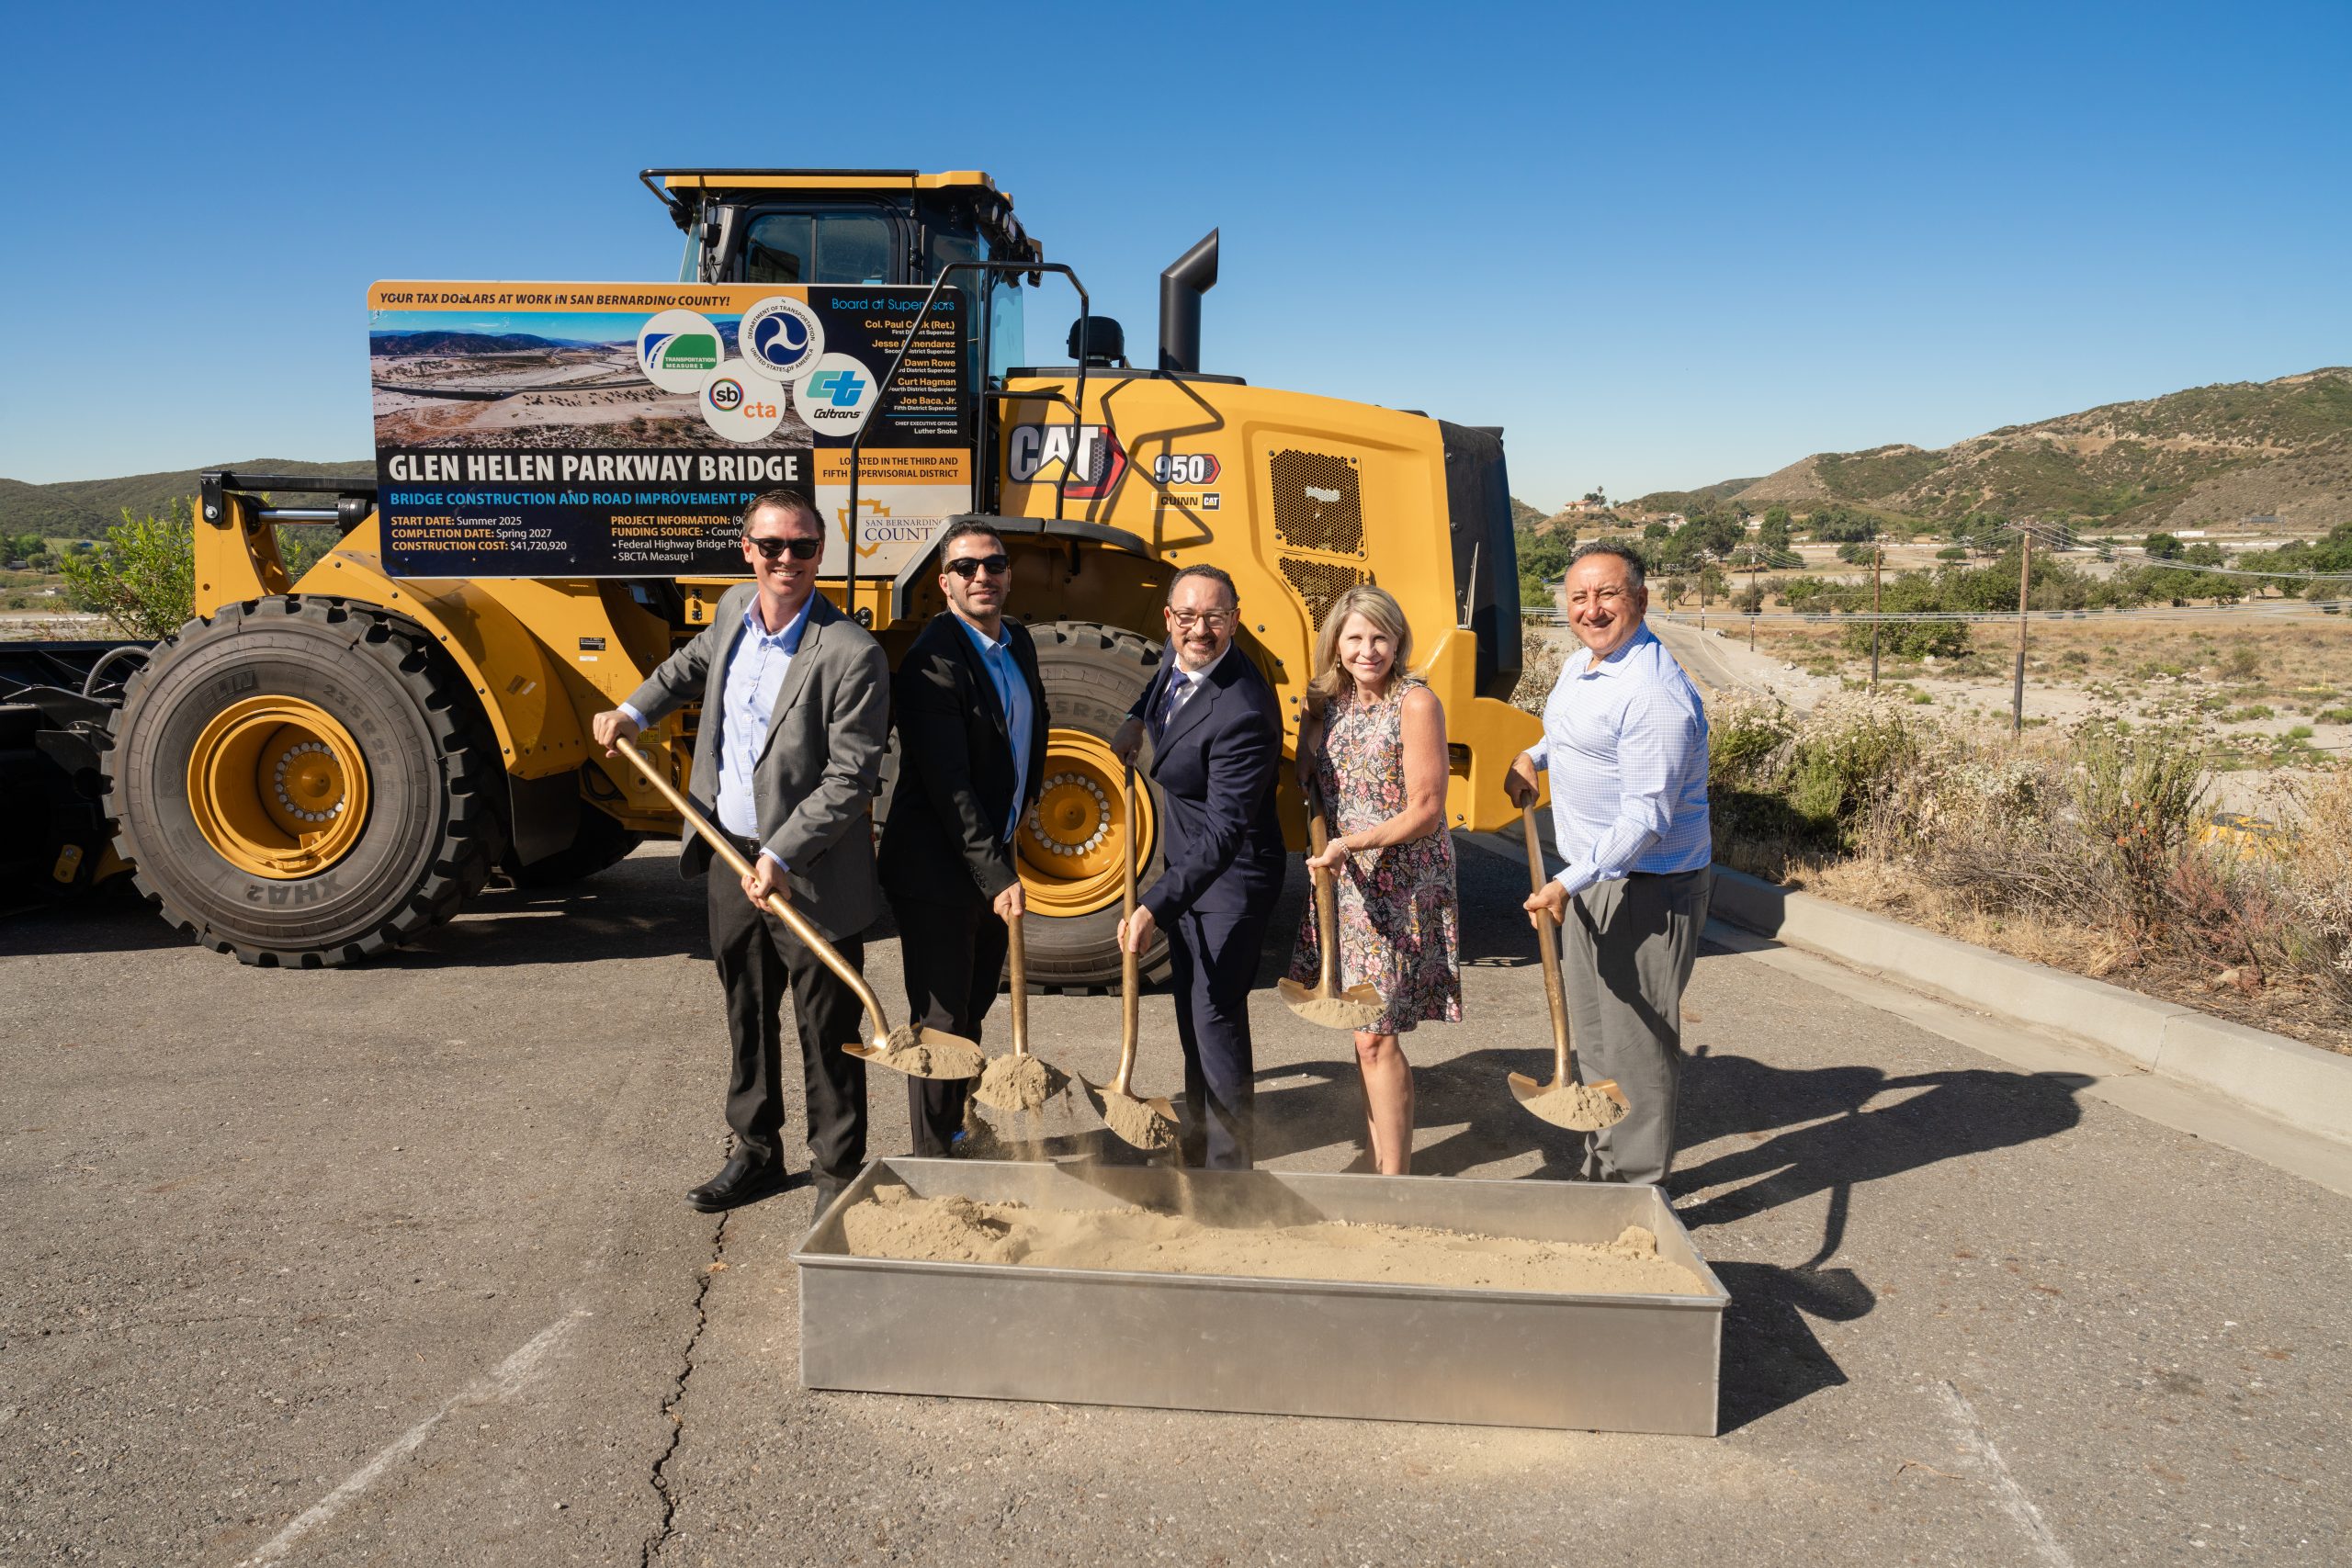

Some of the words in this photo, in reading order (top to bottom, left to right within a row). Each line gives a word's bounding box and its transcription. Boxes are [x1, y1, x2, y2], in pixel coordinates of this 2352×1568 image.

[380, 293, 413, 303] YOUR
[416, 293, 438, 303] TAX
[441, 293, 495, 304] DOLLARS
[498, 294, 514, 304] AT
[515, 294, 552, 304] WORK
[554, 294, 567, 304] IN
[570, 295, 594, 305] SAN
[596, 295, 676, 306] BERNARDINO
[678, 296, 730, 306] COUNTY!
[831, 299, 868, 310] Board
[872, 299, 885, 310] of
[888, 299, 955, 312] Supersors
[748, 309, 771, 340] DEPARTMENT
[780, 305, 816, 342] TRANSPORTATION
[865, 320, 883, 329] Col.
[885, 320, 904, 329] Paul
[931, 320, 956, 330] (Ret.)
[872, 340, 899, 348] Jesse
[750, 347, 766, 367] UNITED
[765, 363, 784, 372] STATES
[786, 364, 796, 372] OF
[795, 348, 814, 369] AMERICA
[904, 358, 930, 367] Dawn
[931, 358, 956, 367] Rowe
[898, 378, 918, 386] Curt
[920, 378, 956, 387] Hagman
[716, 387, 739, 402] sb
[920, 397, 944, 405] Baca,
[743, 401, 777, 419] cta
[813, 408, 861, 419] Caltrans
[1011, 426, 1099, 482] CAT
[840, 457, 878, 466] LOATED
[881, 457, 890, 466] IN
[893, 457, 909, 466] THE
[911, 457, 937, 466] THIRD
[939, 457, 958, 466] AND
[389, 455, 460, 481] GLEN
[467, 455, 555, 481] HELEN
[562, 455, 693, 481] PARKWAY
[699, 456, 798, 481] BRIDGE
[823, 469, 848, 478] FIFTH
[920, 469, 959, 478] DISTRICT
[1155, 455, 1204, 483] 950
[390, 492, 443, 505] BRIDGE
[447, 492, 556, 505] CONSTRUCTION
[559, 492, 590, 505] AND
[593, 492, 632, 505] ROAD
[635, 492, 737, 505] IMPROVEMENT
[1160, 495, 1198, 506] QUINN
[1204, 497, 1219, 506] CAT
[390, 516, 423, 525] START
[425, 516, 455, 525] DATE:
[457, 516, 497, 525] Summer
[499, 516, 522, 525] 2025
[611, 515, 654, 525] PROJECT
[657, 515, 730, 525] INFORMATION:
[865, 518, 883, 527] SAN
[391, 529, 462, 538] COMPLETION
[464, 529, 494, 538] DATE:
[496, 529, 526, 540] Spring
[528, 529, 551, 538] 2027
[612, 527, 659, 536] FUNDING
[660, 527, 703, 536] SOURCE:
[711, 527, 742, 539] County
[865, 527, 935, 541] COUNT
[392, 541, 476, 550] CONSTRUCTION
[478, 541, 508, 550] COST:
[510, 540, 567, 552] $41,720,920
[618, 540, 652, 549] Federal
[654, 540, 695, 551] Highway
[696, 540, 726, 551] Bridge
[618, 552, 647, 561] SBCTA
[650, 552, 688, 561] Measure
[246, 873, 345, 906] XHA2
